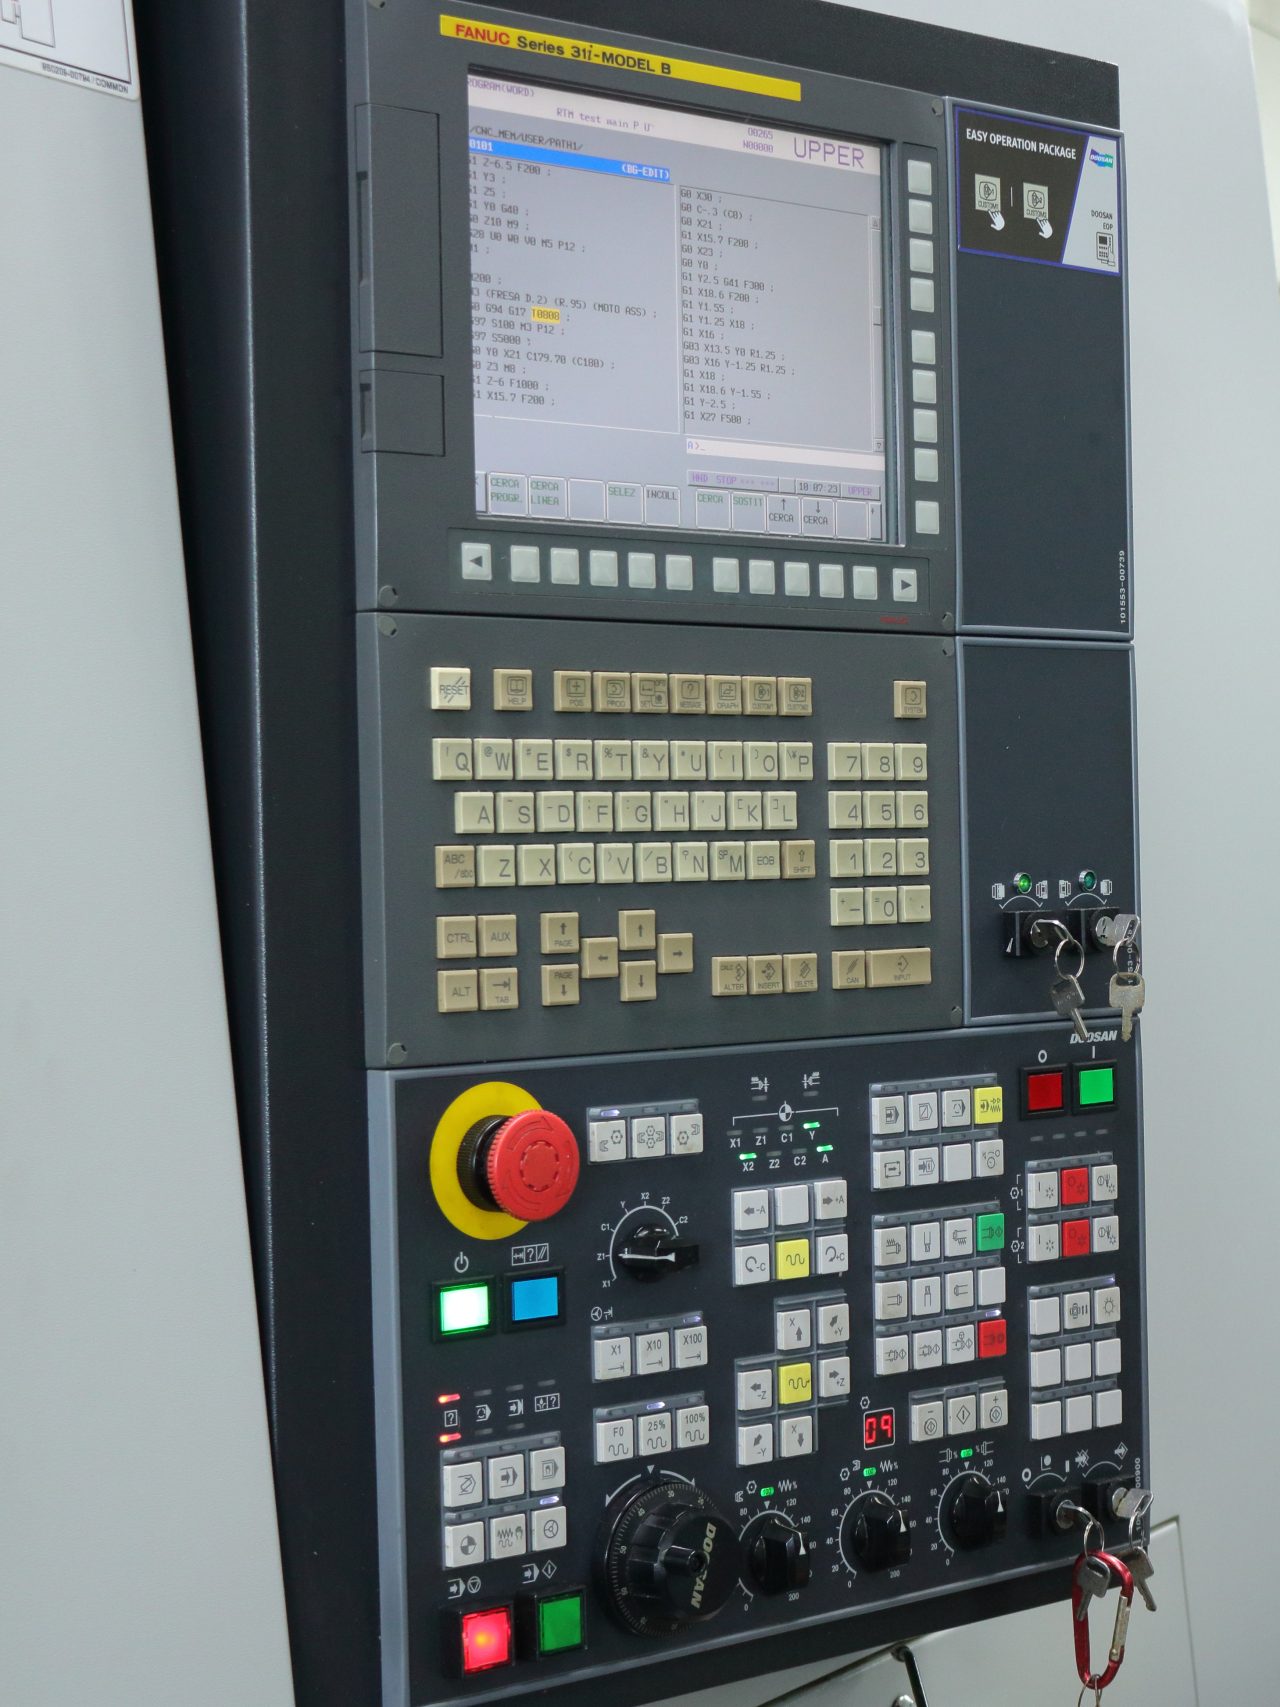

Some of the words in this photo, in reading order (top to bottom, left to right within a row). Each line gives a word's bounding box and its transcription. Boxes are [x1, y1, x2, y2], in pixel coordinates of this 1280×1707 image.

[455, 24, 510, 46] FANUC
[517, 36, 565, 56] Series
[661, 62, 671, 74] B
[580, 112, 600, 124] test
[966, 128, 988, 144] EASY
[989, 132, 1037, 154] OPERATION
[1038, 142, 1077, 160] PACKAGE
[794, 136, 864, 169] UPPER
[1090, 154, 1114, 164] DOOSAN
[1091, 209, 1113, 220] DOOSAN
[768, 512, 794, 524] CERCA
[804, 515, 828, 526] CERCA
[439, 684, 470, 696] RESET
[846, 755, 858, 773] 7
[879, 756, 890, 774] 8
[912, 756, 924, 774] 9
[478, 804, 491, 824] A
[847, 804, 858, 822] 4
[881, 804, 892, 821] 5
[914, 804, 925, 821] 6
[444, 854, 465, 864] ABC
[850, 852, 858, 870] 1
[882, 852, 894, 870] 2
[914, 851, 926, 869] 3
[498, 858, 512, 878] Z
[538, 858, 552, 876] X
[446, 932, 474, 944] CTRL
[490, 931, 511, 942] AUX
[452, 986, 472, 997] ALT
[730, 1138, 740, 1148] X1
[756, 1136, 767, 1146] Z1
[781, 1133, 793, 1143] C1
[809, 1130, 816, 1140] Y
[742, 1162, 754, 1172] X2
[769, 1158, 780, 1169] Z2
[794, 1156, 807, 1166] C2
[822, 1154, 829, 1164] A
[640, 1192, 650, 1200] X2
[661, 1196, 671, 1205] Z2
[679, 1216, 688, 1224] C2
[600, 1224, 610, 1232] C1
[683, 1333, 702, 1346] X100
[611, 1344, 622, 1356] X1
[646, 1340, 662, 1352] X10
[685, 1412, 706, 1424] 100%
[614, 1426, 624, 1438] F0
[648, 1420, 666, 1432] 25%
[865, 1414, 892, 1444] 09
